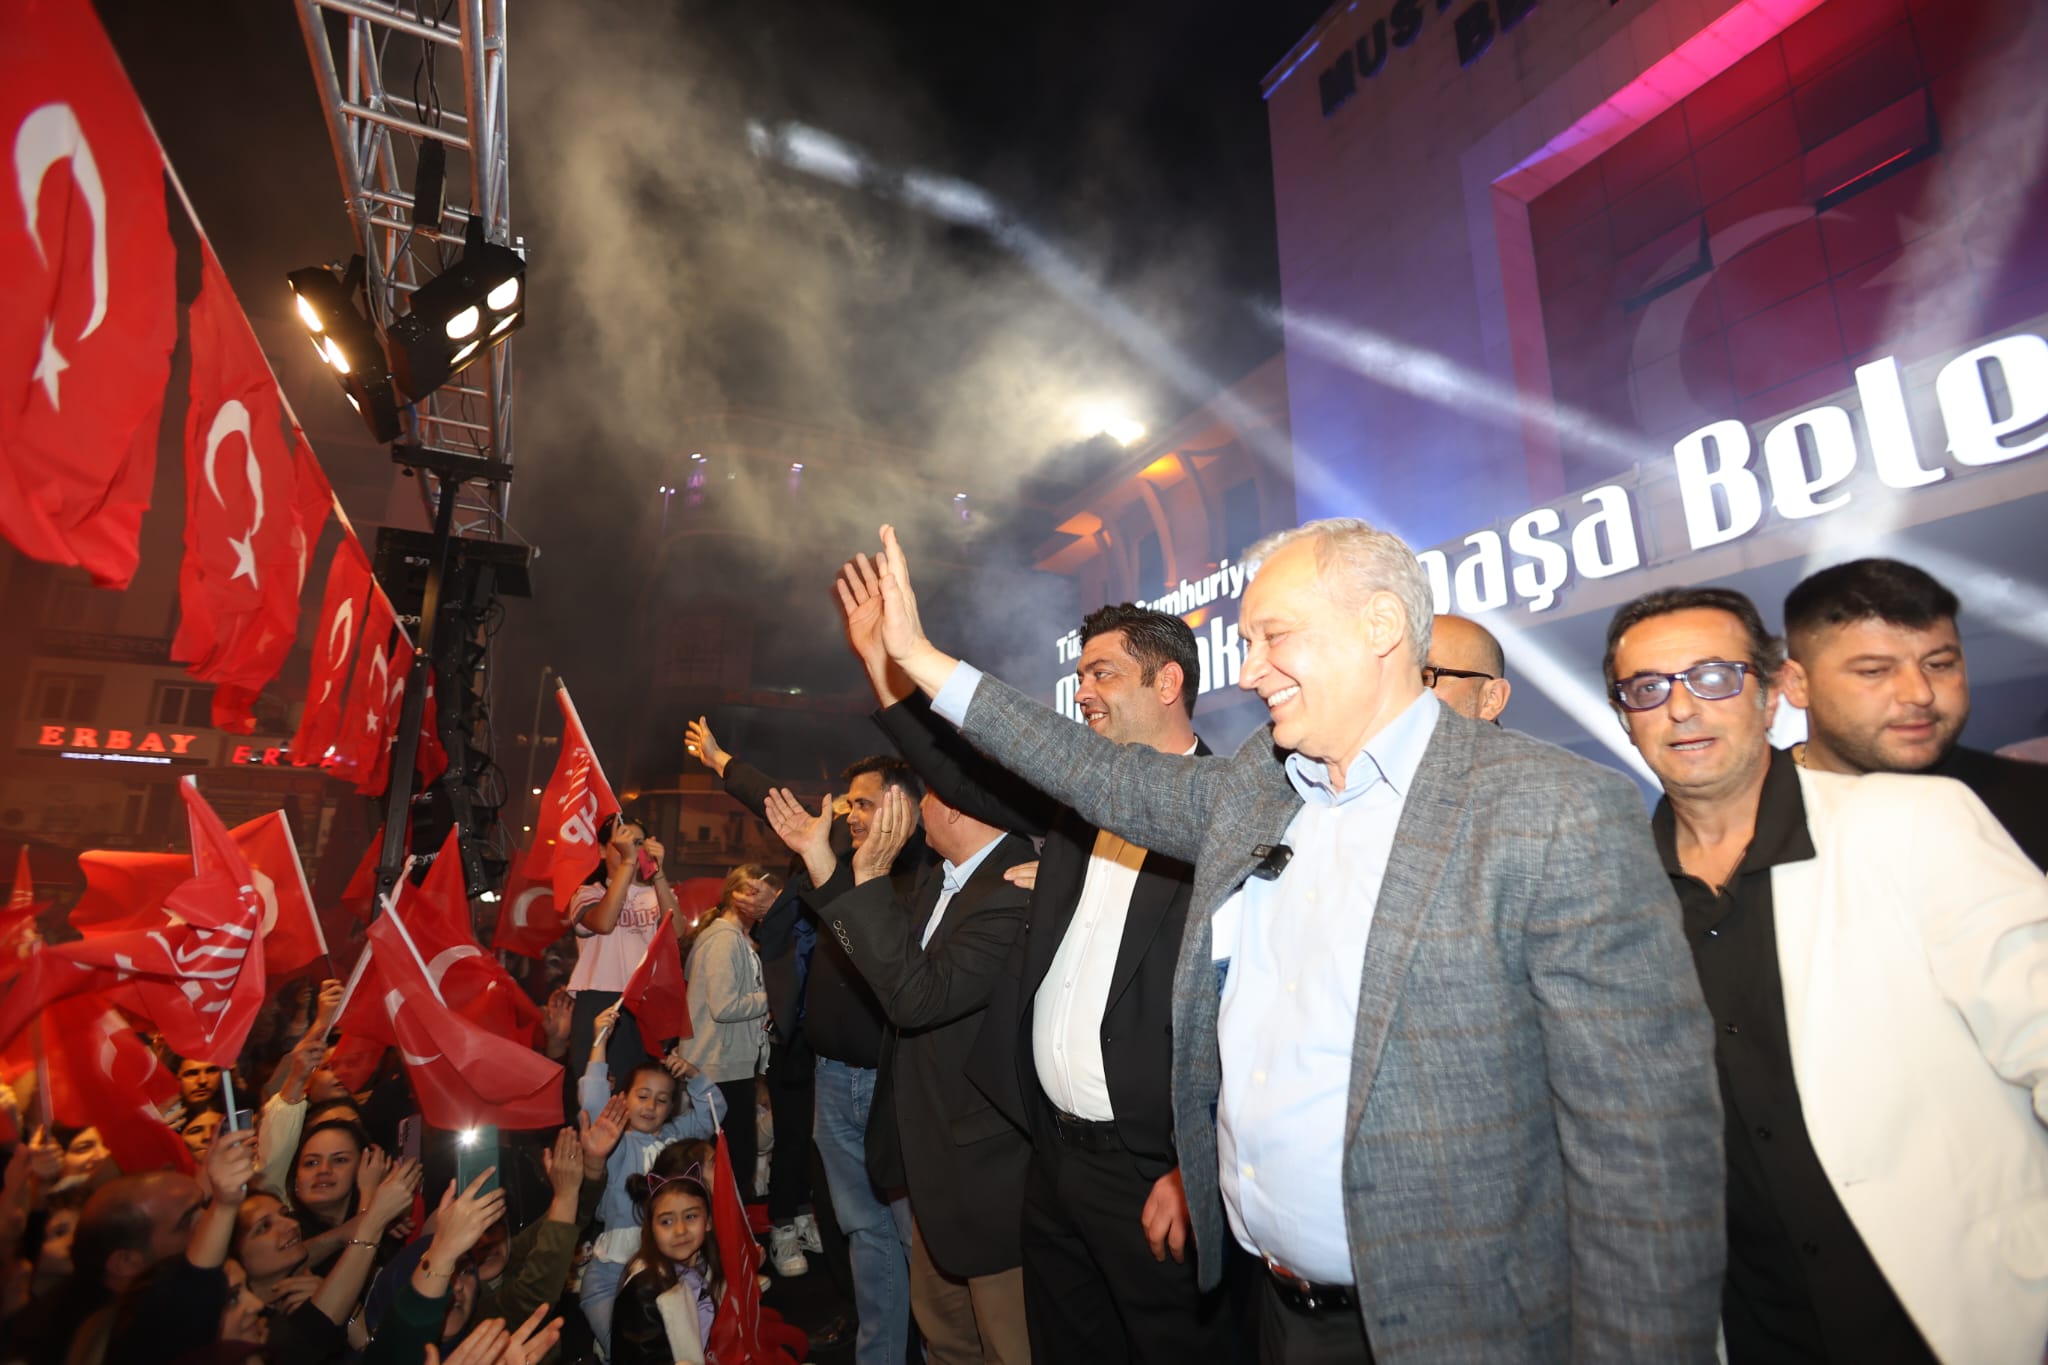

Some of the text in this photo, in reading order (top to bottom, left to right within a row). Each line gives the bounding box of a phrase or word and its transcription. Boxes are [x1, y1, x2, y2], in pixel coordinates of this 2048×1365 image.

[1318, 0, 1453, 118] MUS
[1673, 333, 2048, 551] Bele
[38, 725, 197, 754] ERBAY
